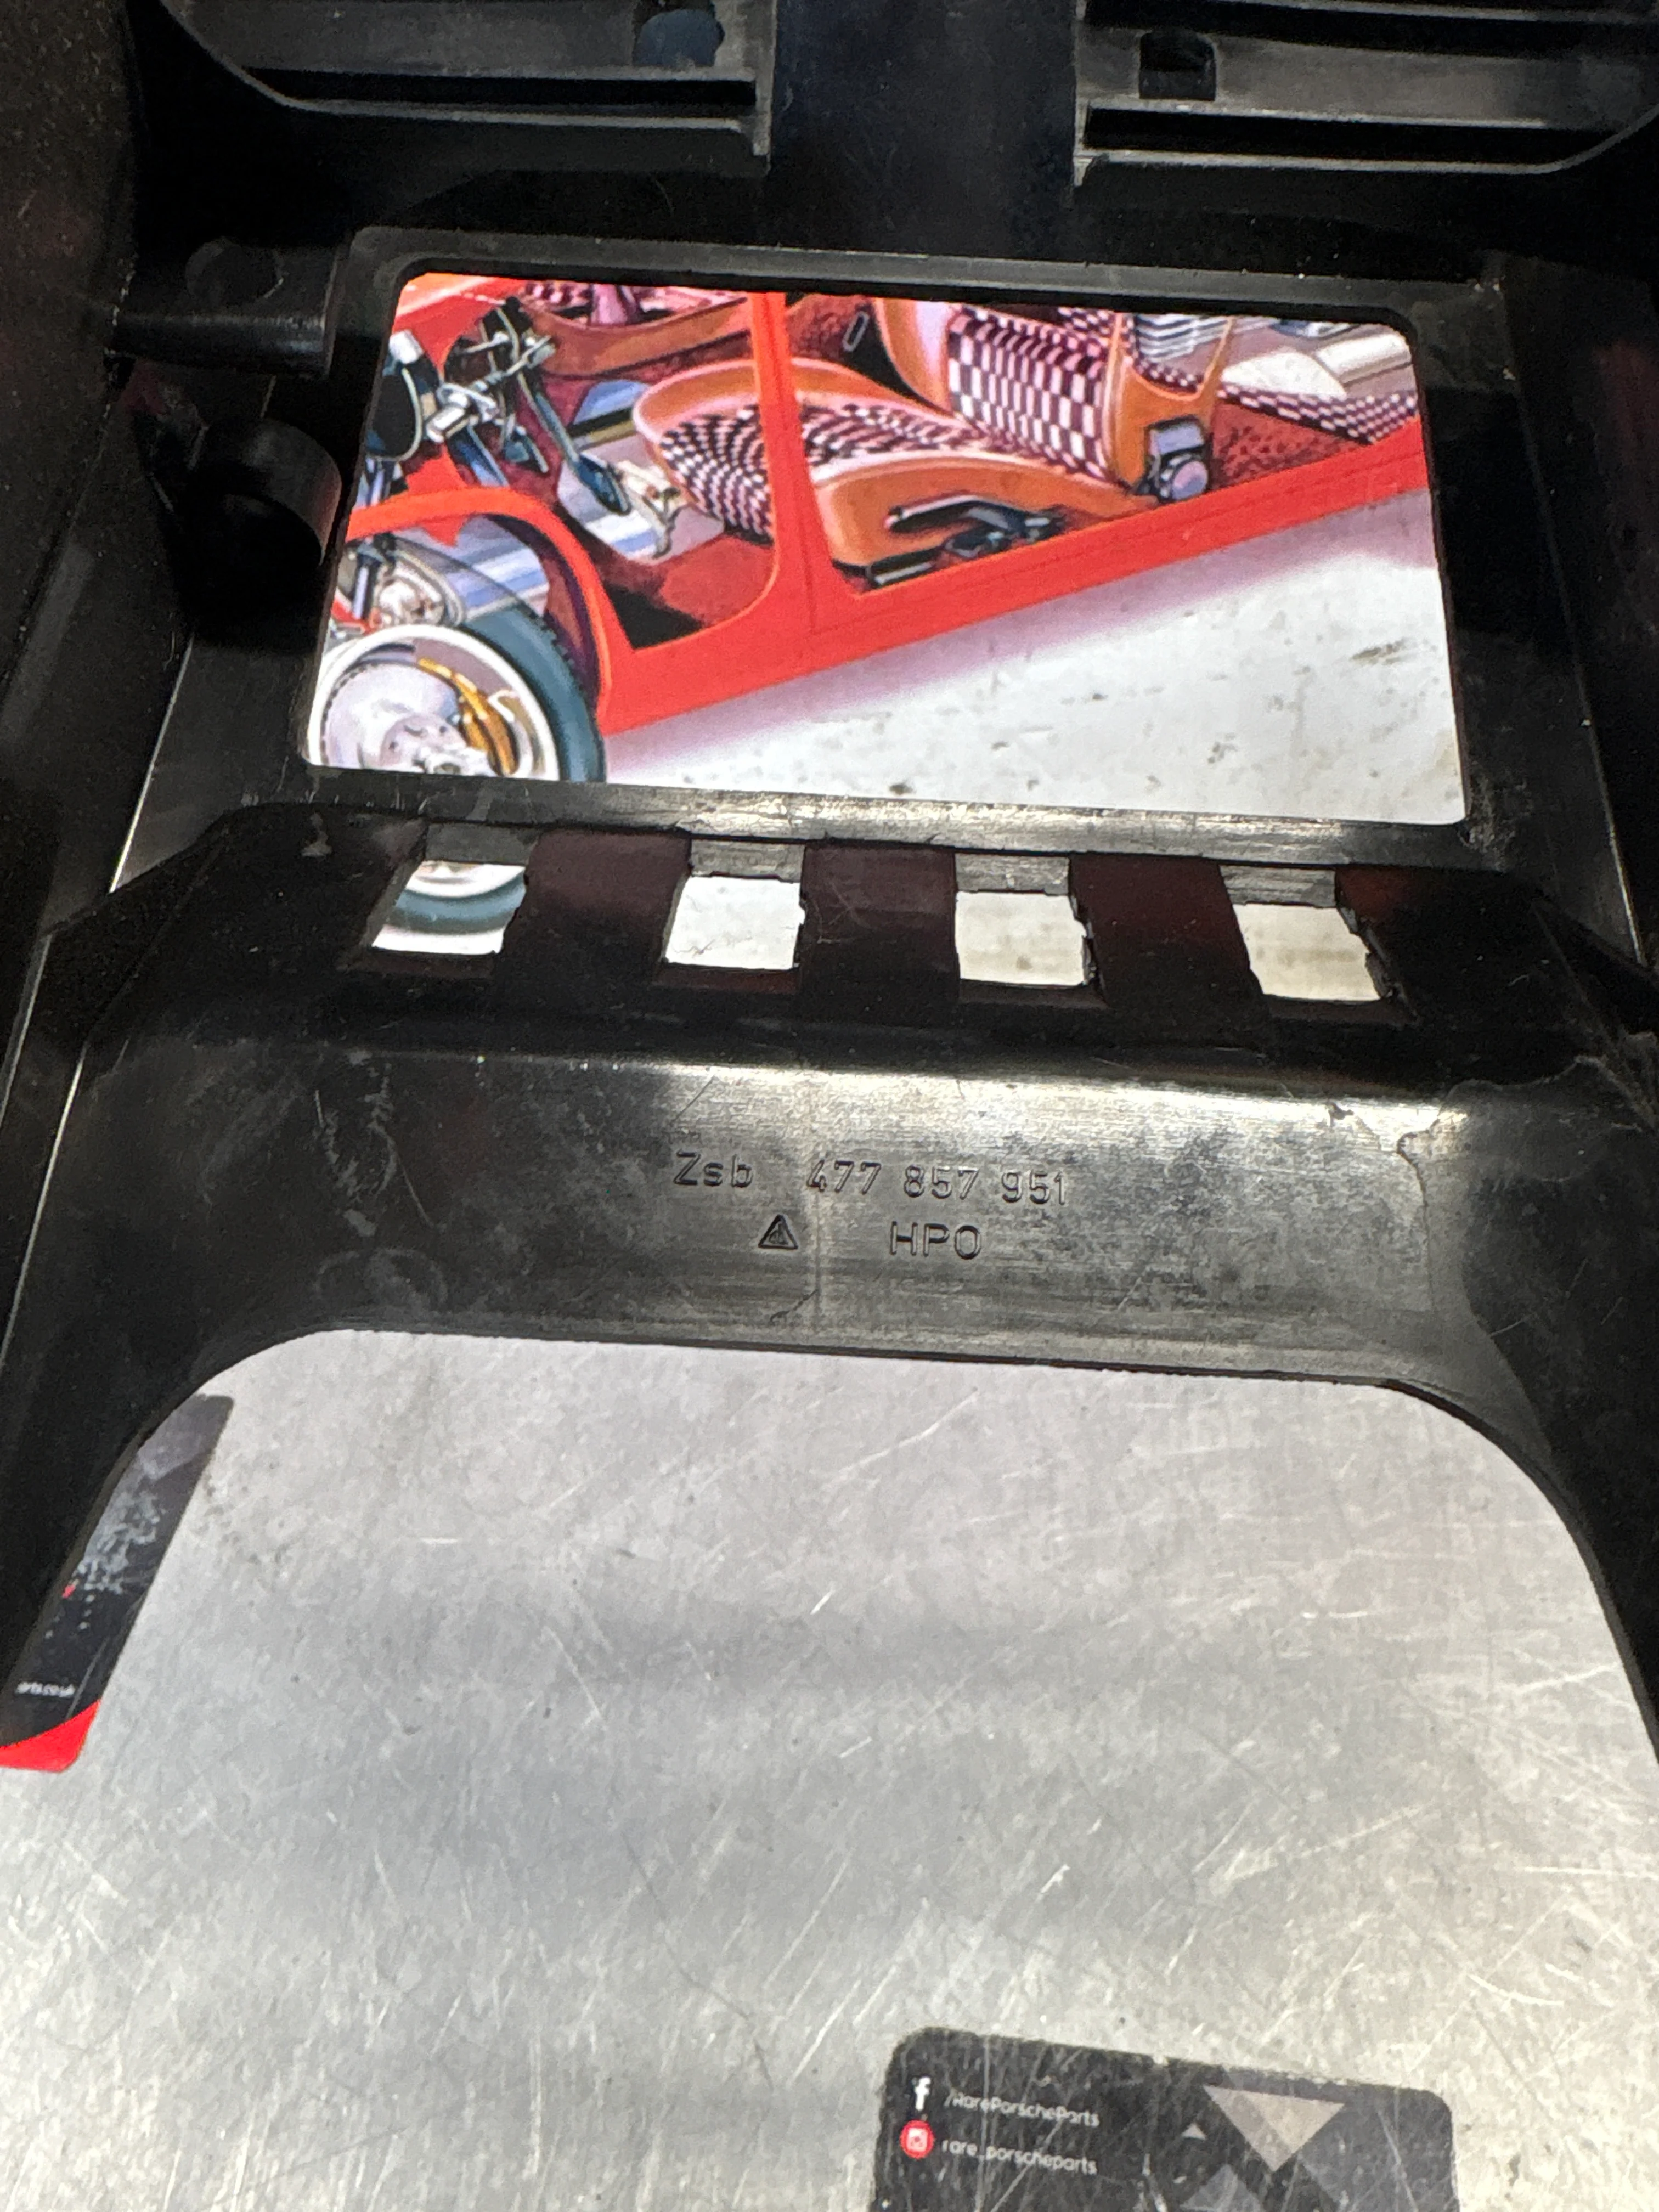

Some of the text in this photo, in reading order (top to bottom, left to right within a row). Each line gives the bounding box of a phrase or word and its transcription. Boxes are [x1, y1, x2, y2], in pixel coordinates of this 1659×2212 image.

[673, 1150, 1066, 1205] Zsb 477 857 951
